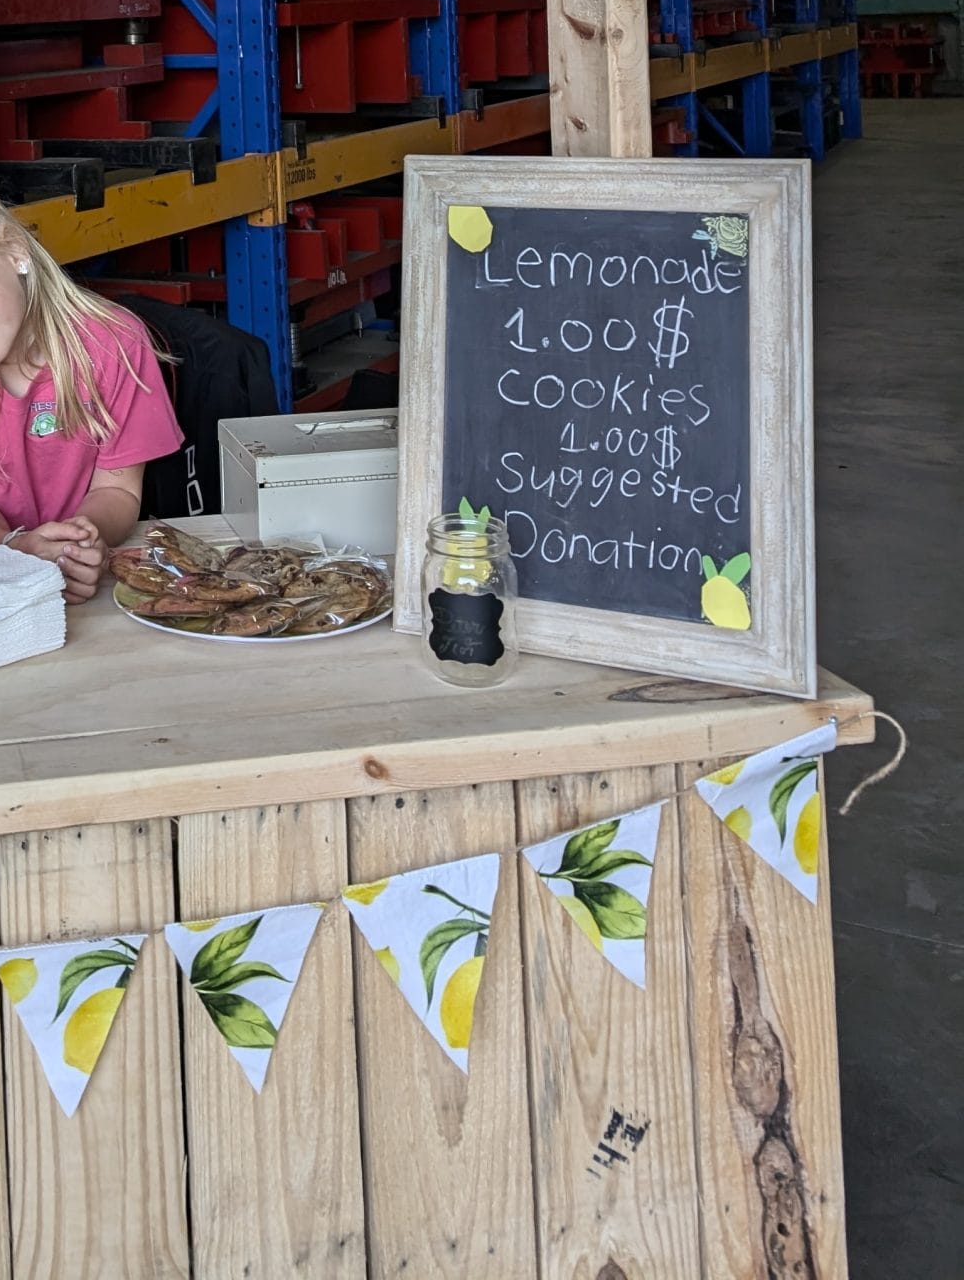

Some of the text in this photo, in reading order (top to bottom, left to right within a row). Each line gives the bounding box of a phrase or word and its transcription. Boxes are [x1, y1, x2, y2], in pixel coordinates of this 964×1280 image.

[286, 167, 316, 185] 12000 lbs
[483, 245, 746, 295] Lemonade
[496, 451, 743, 523] Suggested
[503, 510, 707, 576] Donation
